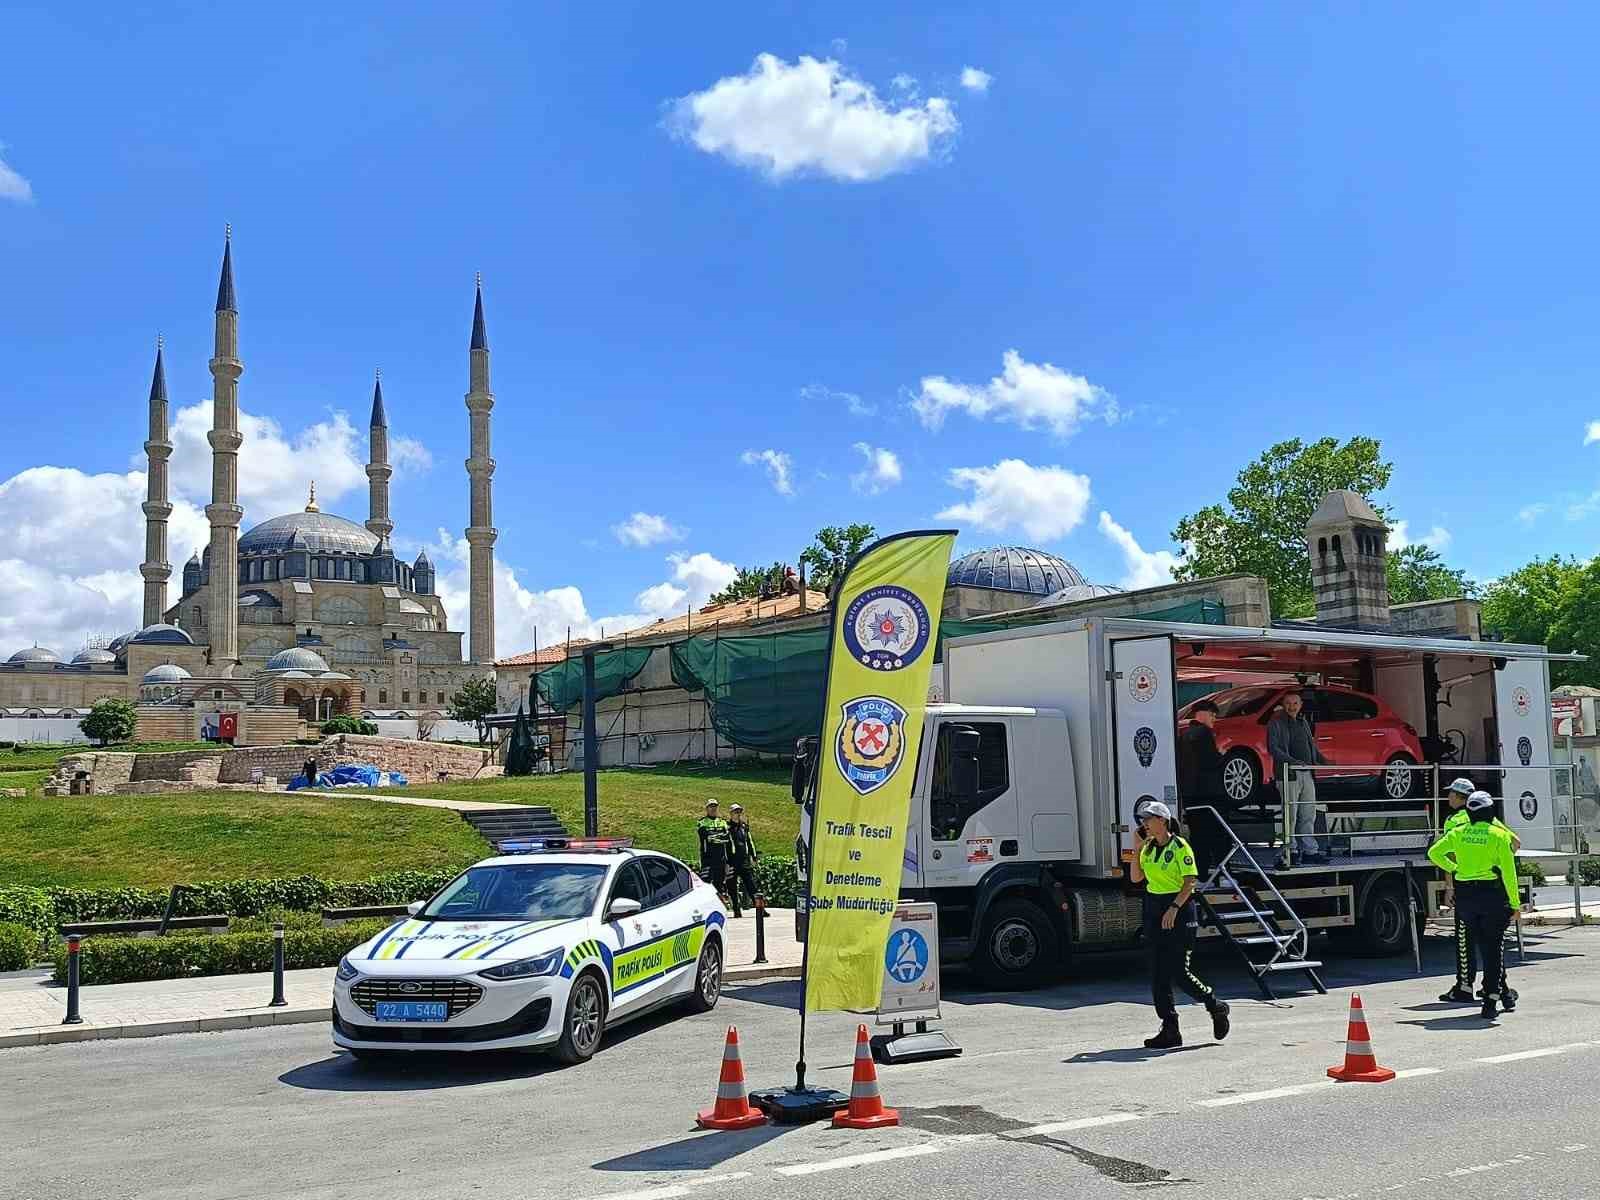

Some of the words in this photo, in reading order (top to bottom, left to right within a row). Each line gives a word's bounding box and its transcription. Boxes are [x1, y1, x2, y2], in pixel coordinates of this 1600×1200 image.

[862, 703, 890, 715] POLİS
[826, 821, 856, 836] Trafik
[859, 824, 892, 839] Tescil
[848, 850, 861, 861] ve
[826, 871, 882, 887] Denetleme
[809, 895, 834, 913] Şube
[836, 895, 894, 915] Müdürlüğü
[617, 957, 641, 981] TRAFİK
[641, 948, 663, 972] POLİSİ
[383, 1004, 397, 1017] 22
[403, 1004, 410, 1017] A
[416, 1004, 444, 1017] 5440
